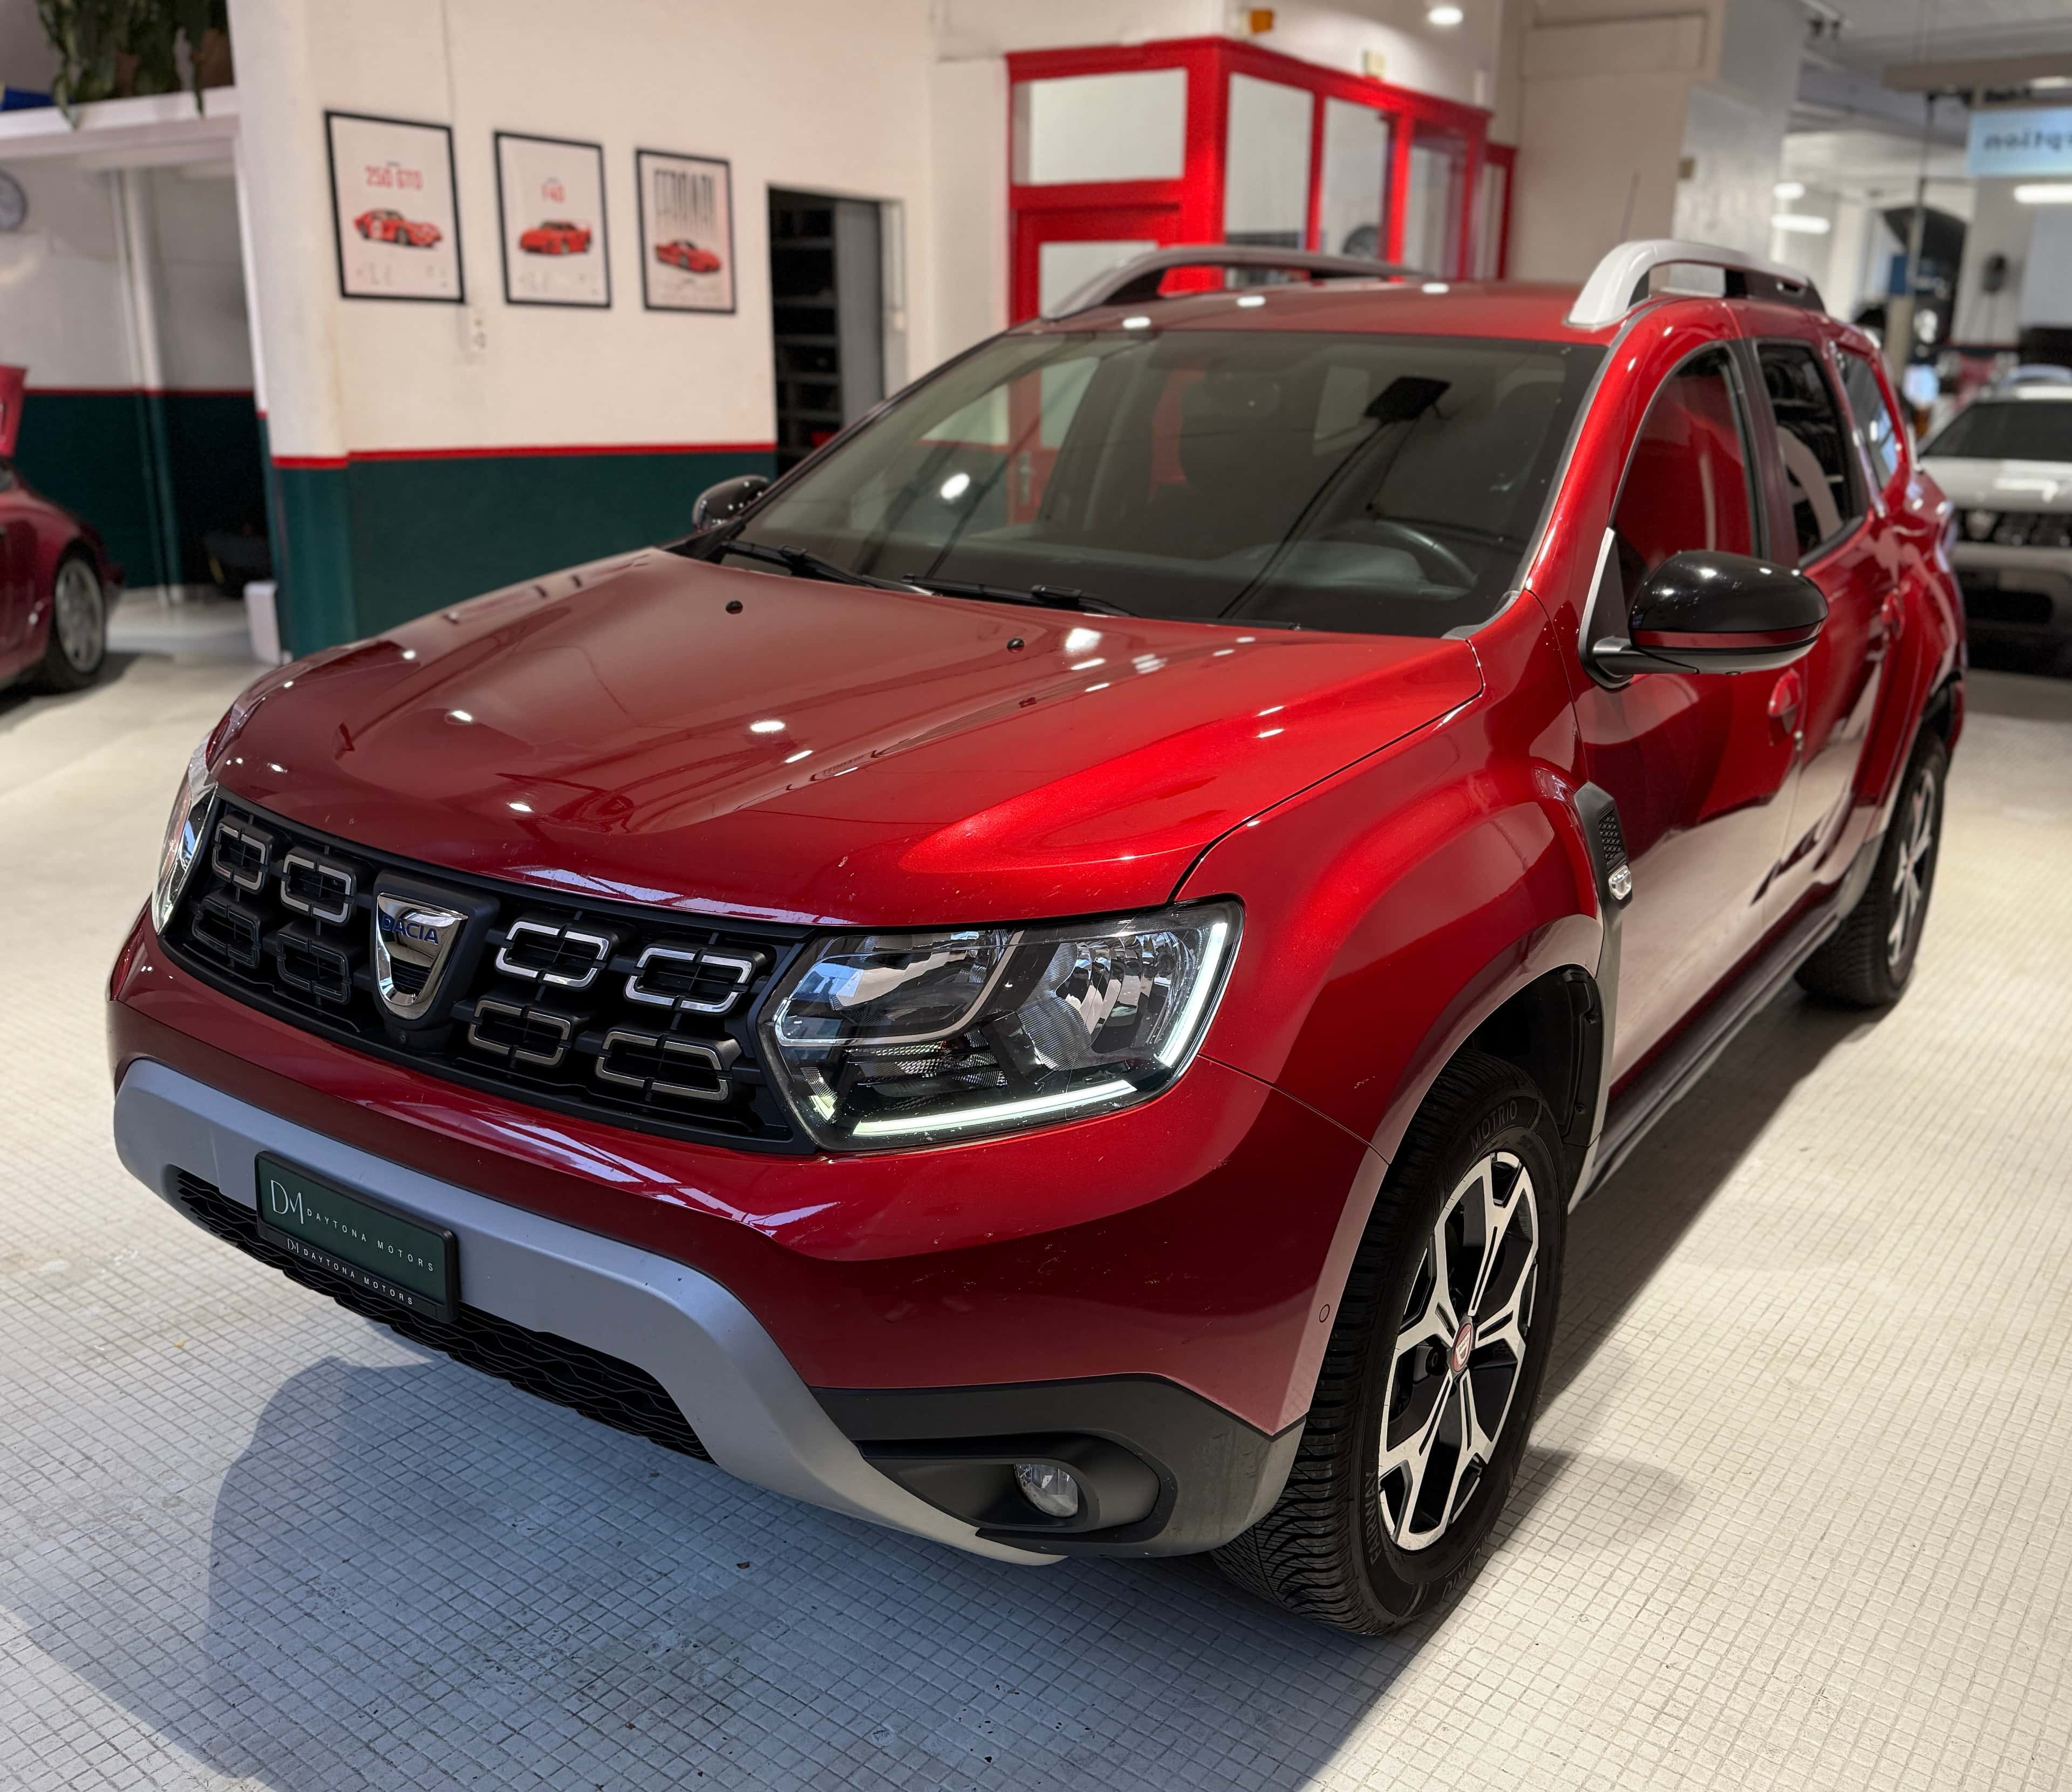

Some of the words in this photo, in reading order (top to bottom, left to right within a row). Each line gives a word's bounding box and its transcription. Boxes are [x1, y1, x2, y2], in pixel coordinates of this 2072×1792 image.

[381, 915, 439, 945] DACIA
[1470, 1099, 1518, 1154] MOTRIO
[271, 1179, 304, 1225] DM
[307, 1208, 367, 1242] DAYTONA
[377, 1240, 434, 1271] MOTORS
[287, 1238, 299, 1254] DM
[304, 1248, 356, 1278] DAYTONA
[364, 1277, 413, 1305] MOTORS
